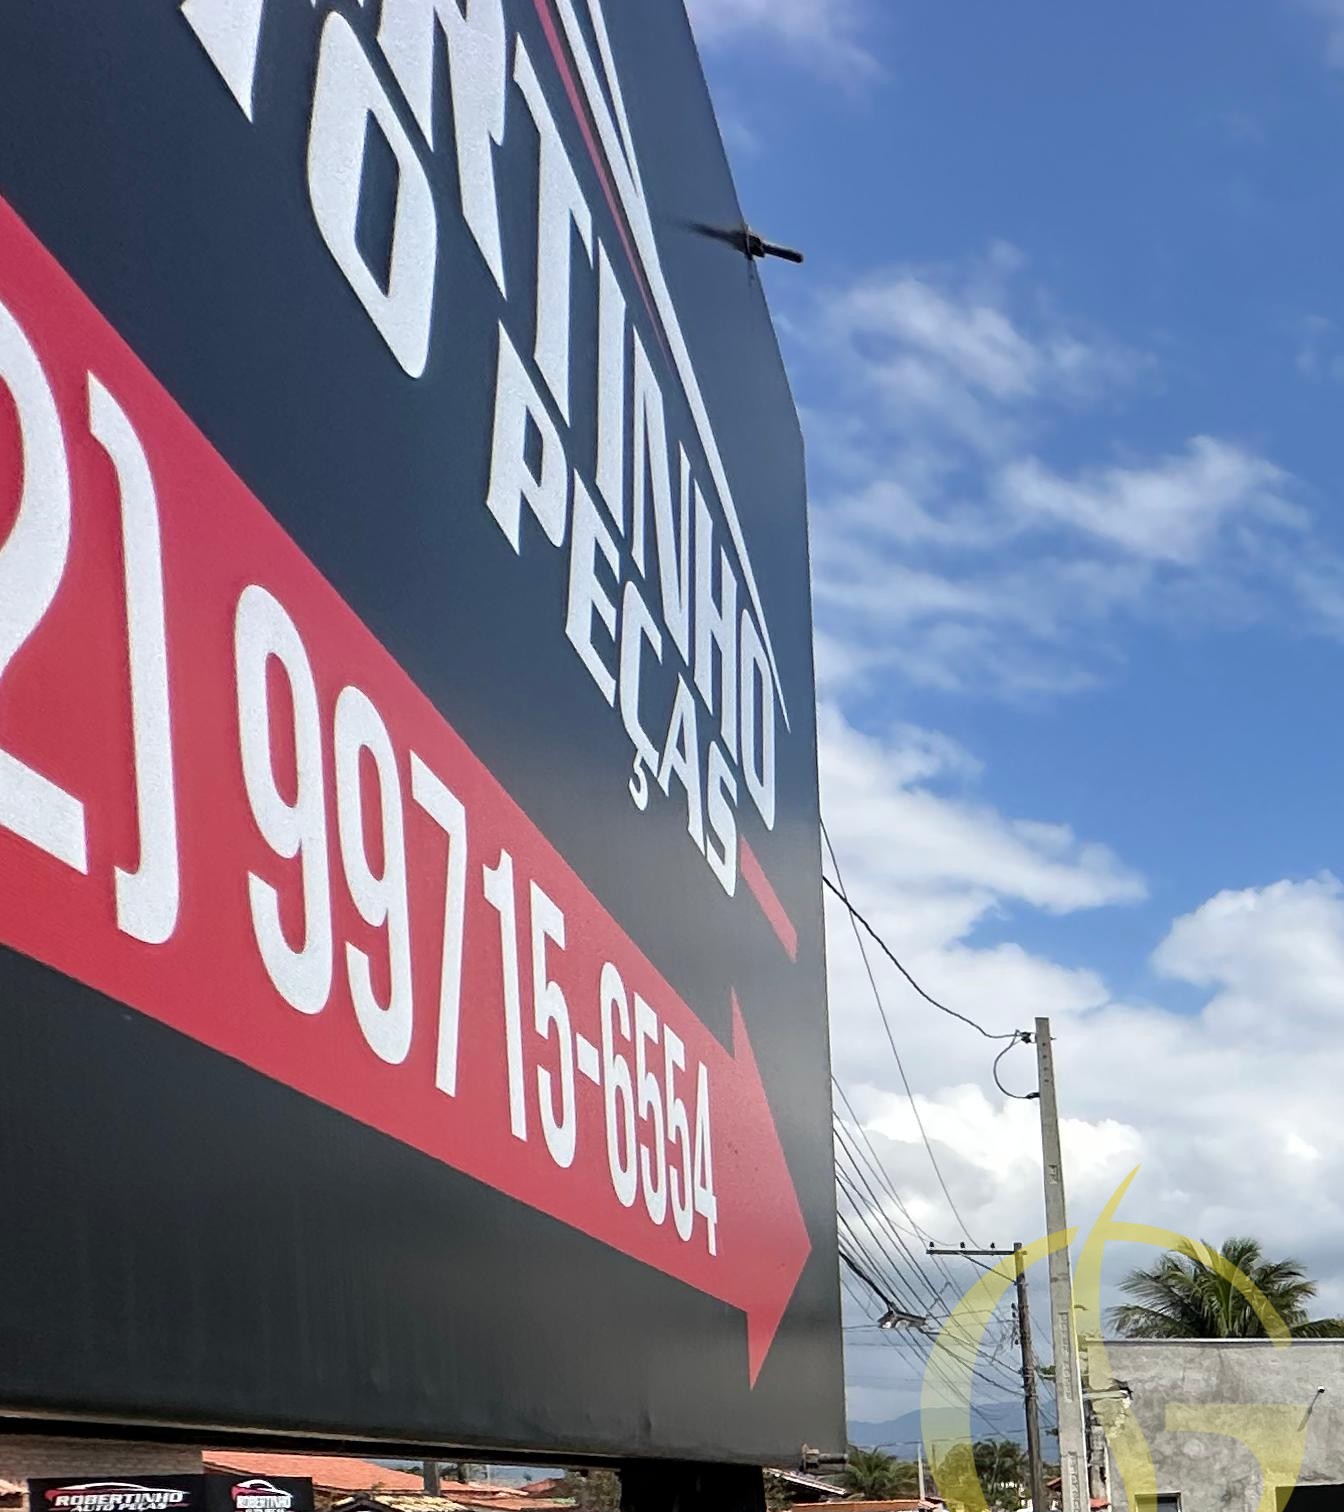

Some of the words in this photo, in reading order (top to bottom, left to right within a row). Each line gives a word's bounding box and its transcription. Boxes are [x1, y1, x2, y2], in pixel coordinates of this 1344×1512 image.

[487, 320, 737, 897] PEÇAS
[235, 584, 717, 1256] 99715-6554
[55, 1492, 184, 1506] ROBERTINHO
